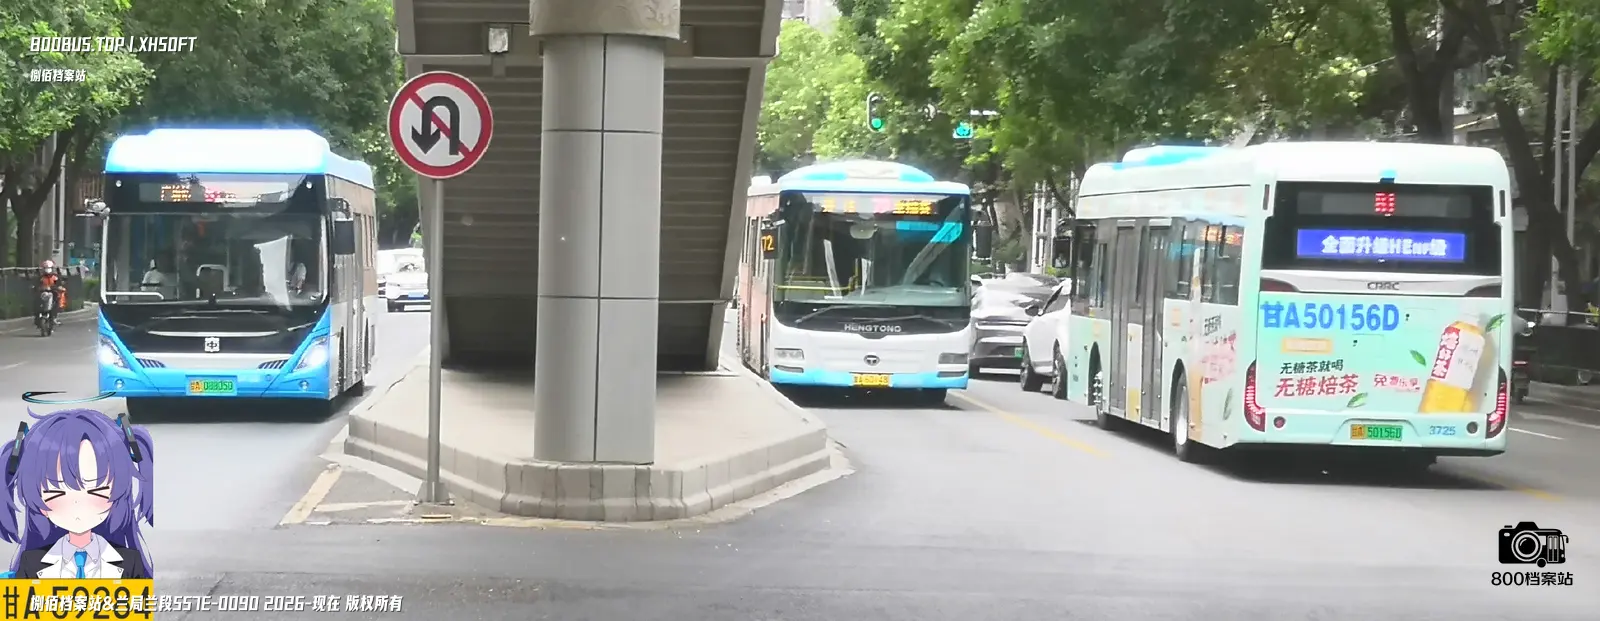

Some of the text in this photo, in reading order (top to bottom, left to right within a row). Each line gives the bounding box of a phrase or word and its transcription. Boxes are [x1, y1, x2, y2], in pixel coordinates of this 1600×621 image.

[761, 234, 775, 252] 72
[1367, 281, 1400, 291] CRRC
[1260, 300, 1399, 331] 甘A50156D
[1280, 359, 1344, 375] 无糖茶就喝
[1275, 373, 1359, 398] 无糖焙茶
[1429, 425, 1456, 436] 3725
